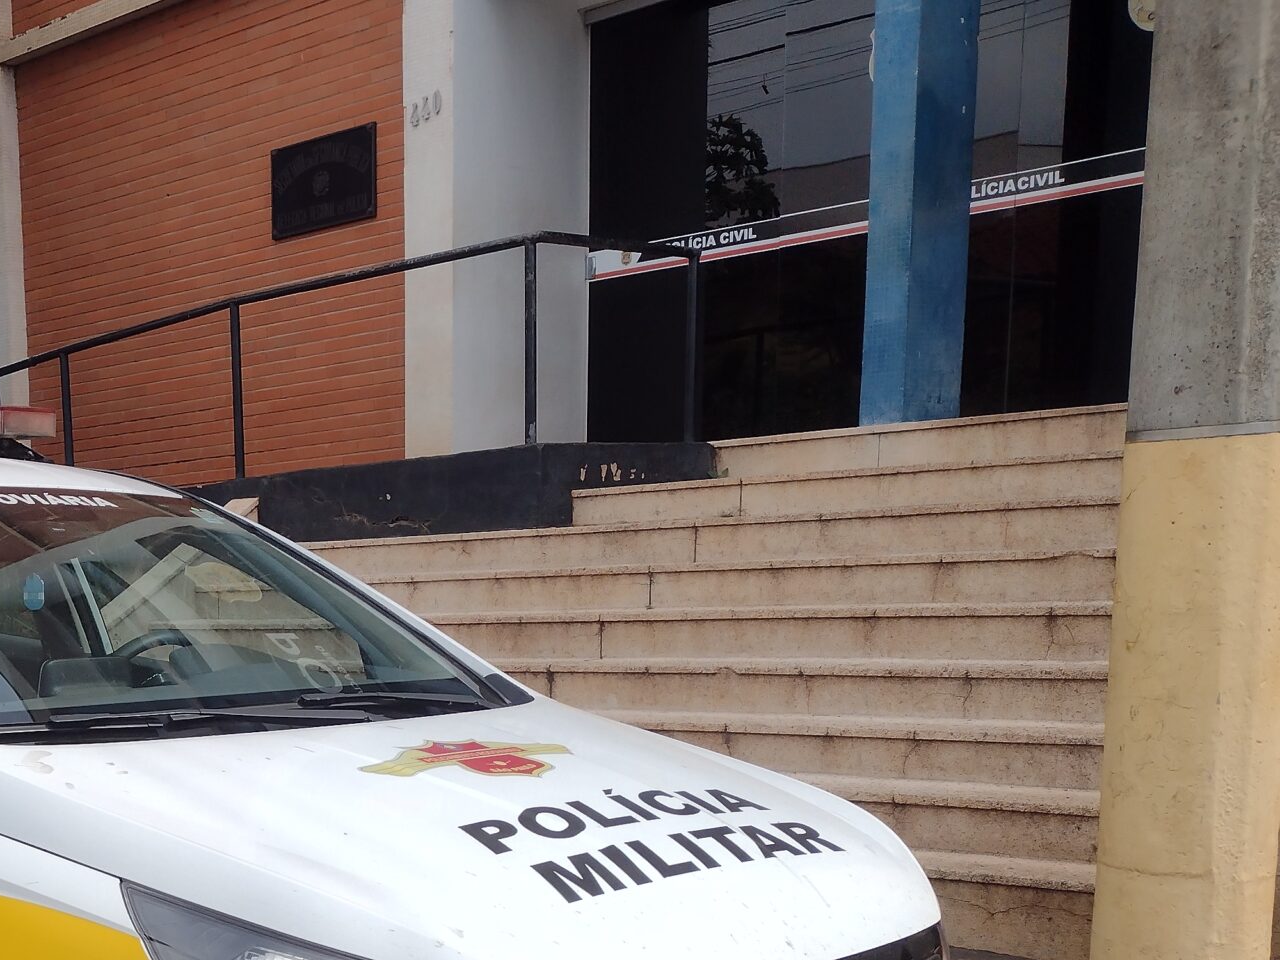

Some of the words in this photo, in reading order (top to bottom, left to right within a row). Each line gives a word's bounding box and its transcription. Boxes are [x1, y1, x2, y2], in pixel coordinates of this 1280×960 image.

[971, 180, 1016, 198] LÍCIA
[1017, 170, 1065, 190] CIVIL
[719, 228, 757, 243] CIVIL
[458, 788, 771, 855] POLÍCIA
[530, 822, 847, 903] MILITAR
